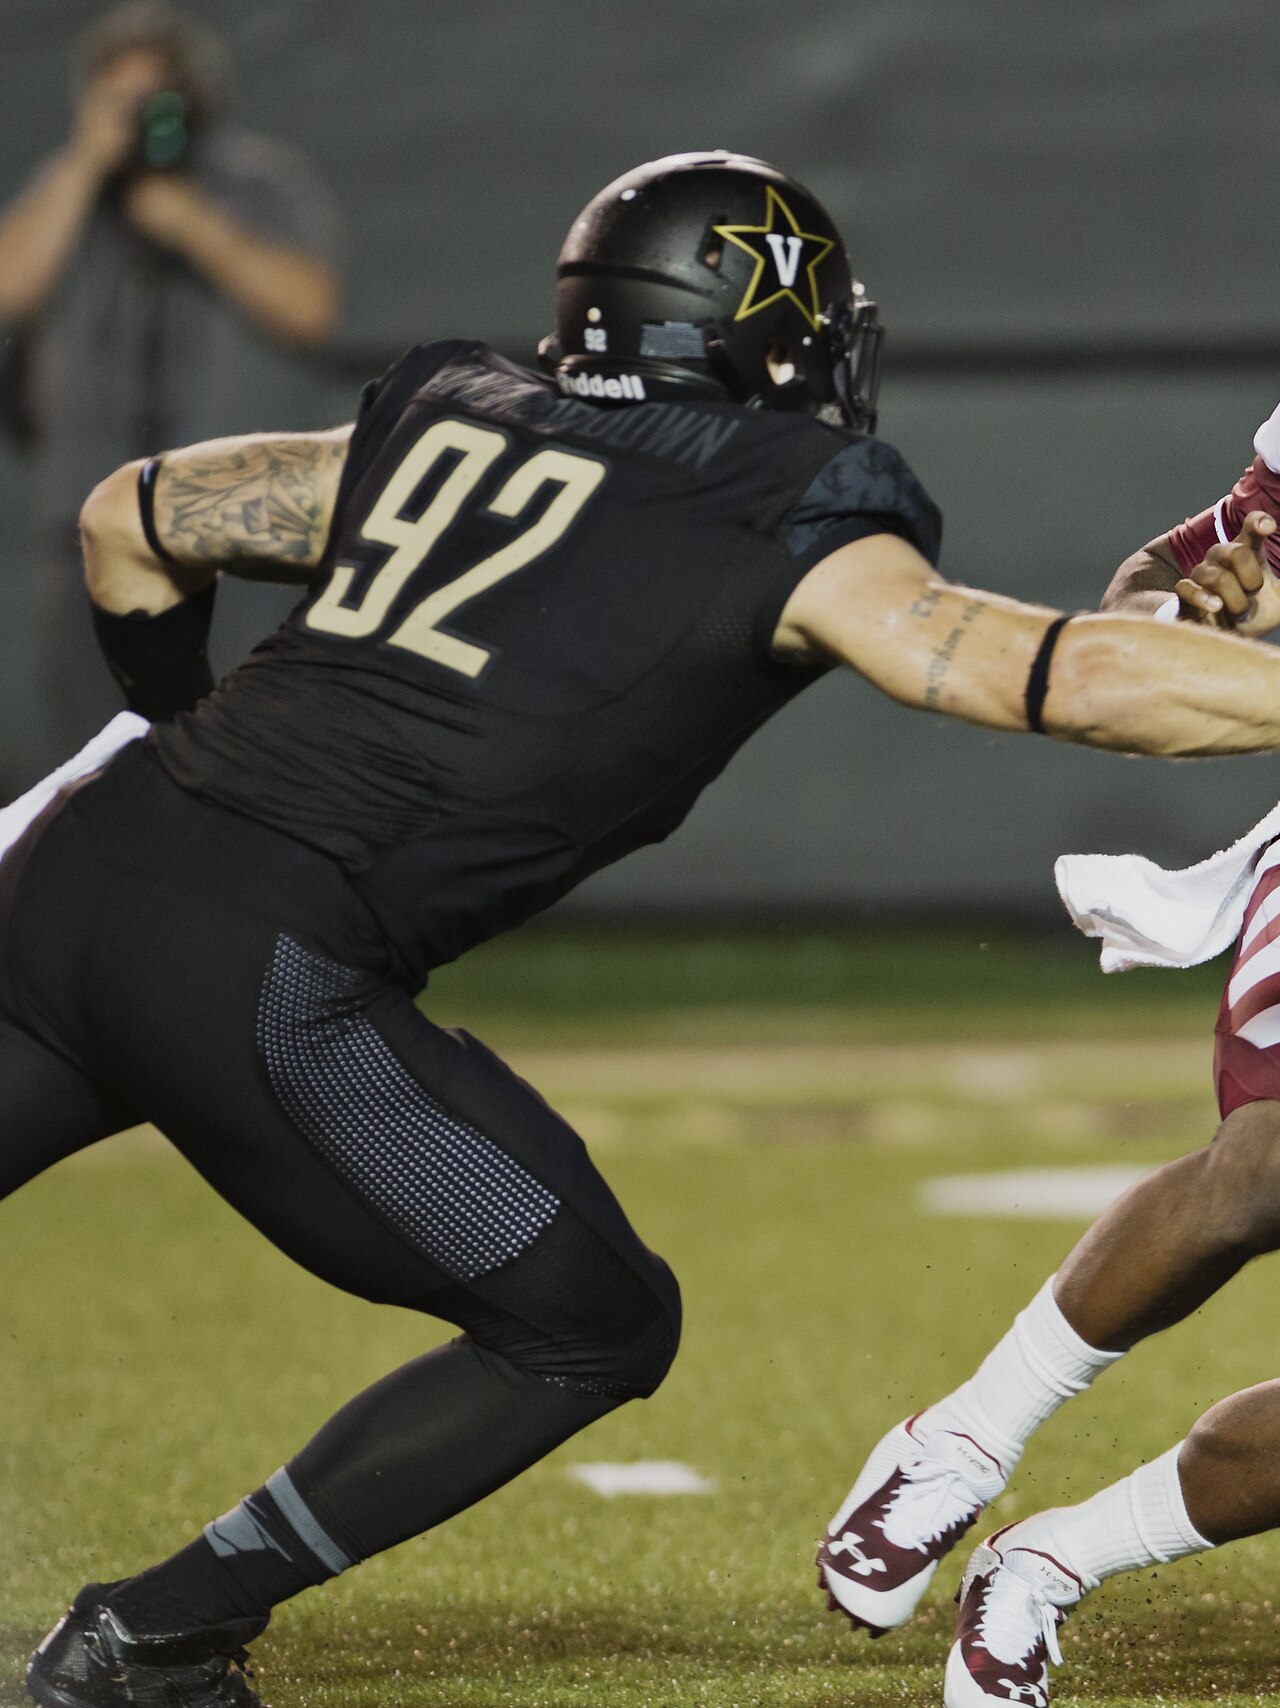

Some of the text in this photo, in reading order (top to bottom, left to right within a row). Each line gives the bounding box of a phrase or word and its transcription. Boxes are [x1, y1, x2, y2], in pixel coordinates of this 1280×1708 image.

[765, 233, 803, 287] V
[583, 327, 608, 352] 92
[305, 419, 606, 679] 92
